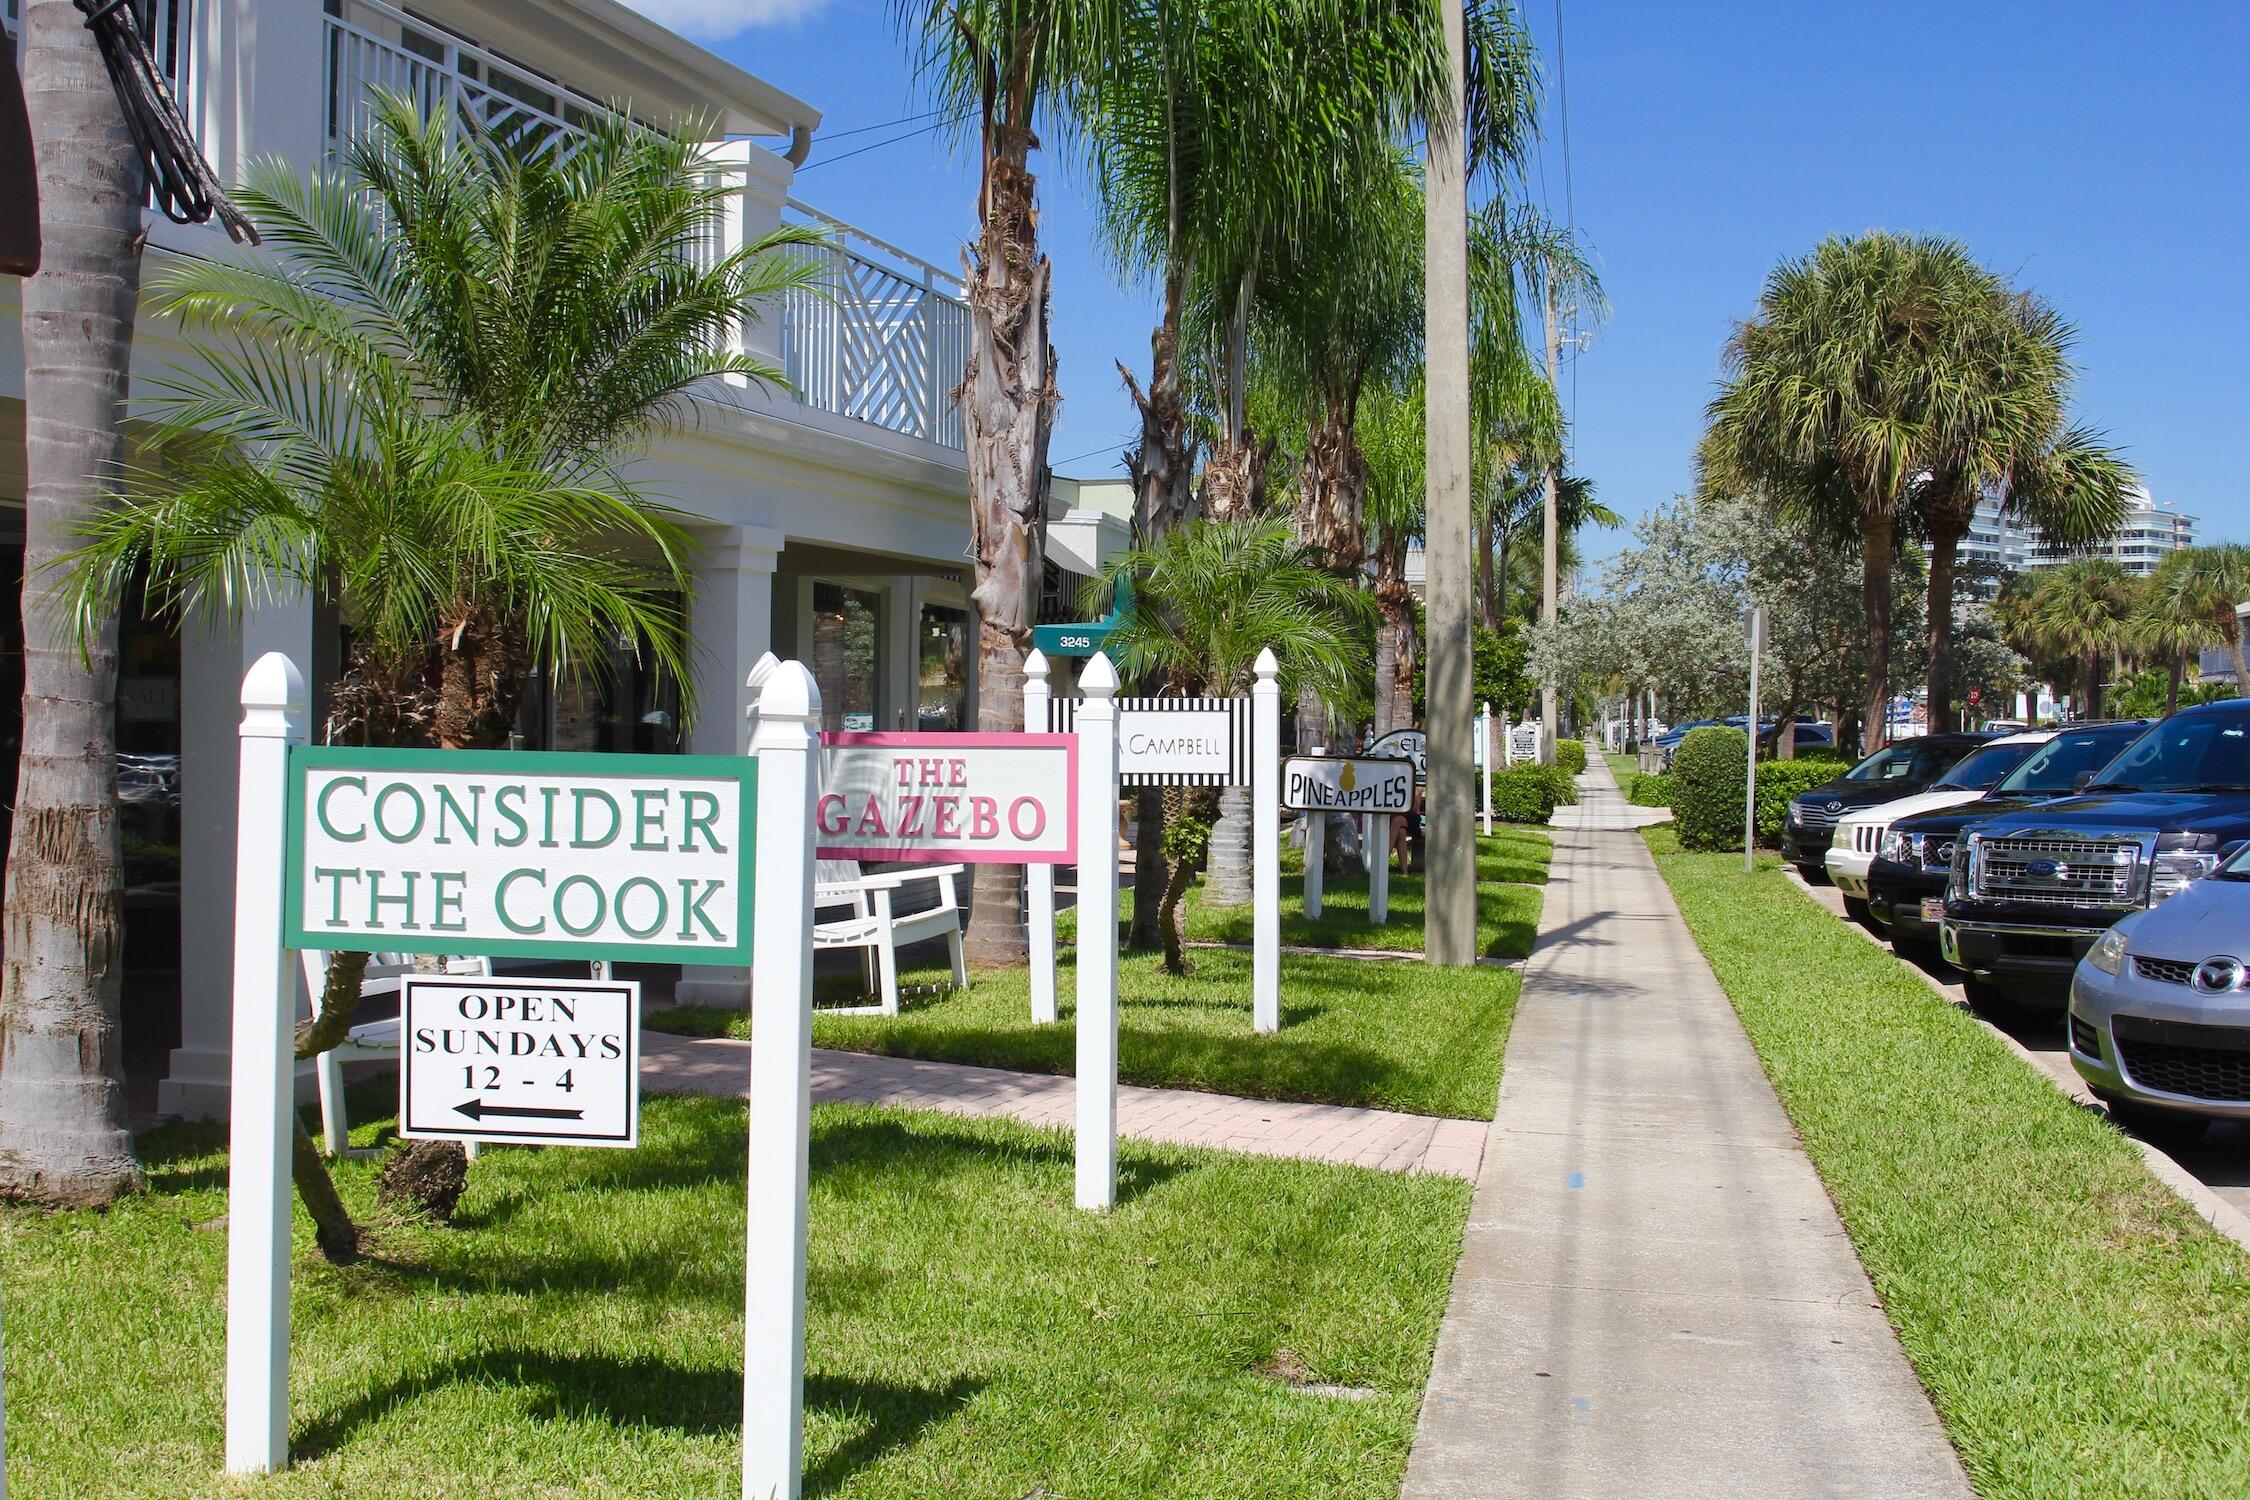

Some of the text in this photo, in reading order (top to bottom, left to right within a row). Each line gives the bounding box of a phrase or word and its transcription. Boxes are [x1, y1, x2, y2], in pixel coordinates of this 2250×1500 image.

[1060, 636, 1090, 648] 3245
[1129, 734, 1220, 755] CAMPBELL
[893, 758, 967, 787] THE
[1290, 773, 1406, 808] PINEAPPLES
[317, 776, 727, 853] CONSIDER
[816, 794, 1046, 841] GAZEBO
[315, 866, 727, 941] THE COOK
[458, 994, 578, 1023] OPEN
[416, 1028, 621, 1060] SUNDAYS
[462, 1065, 501, 1090] 12
[555, 1068, 574, 1093] 4
